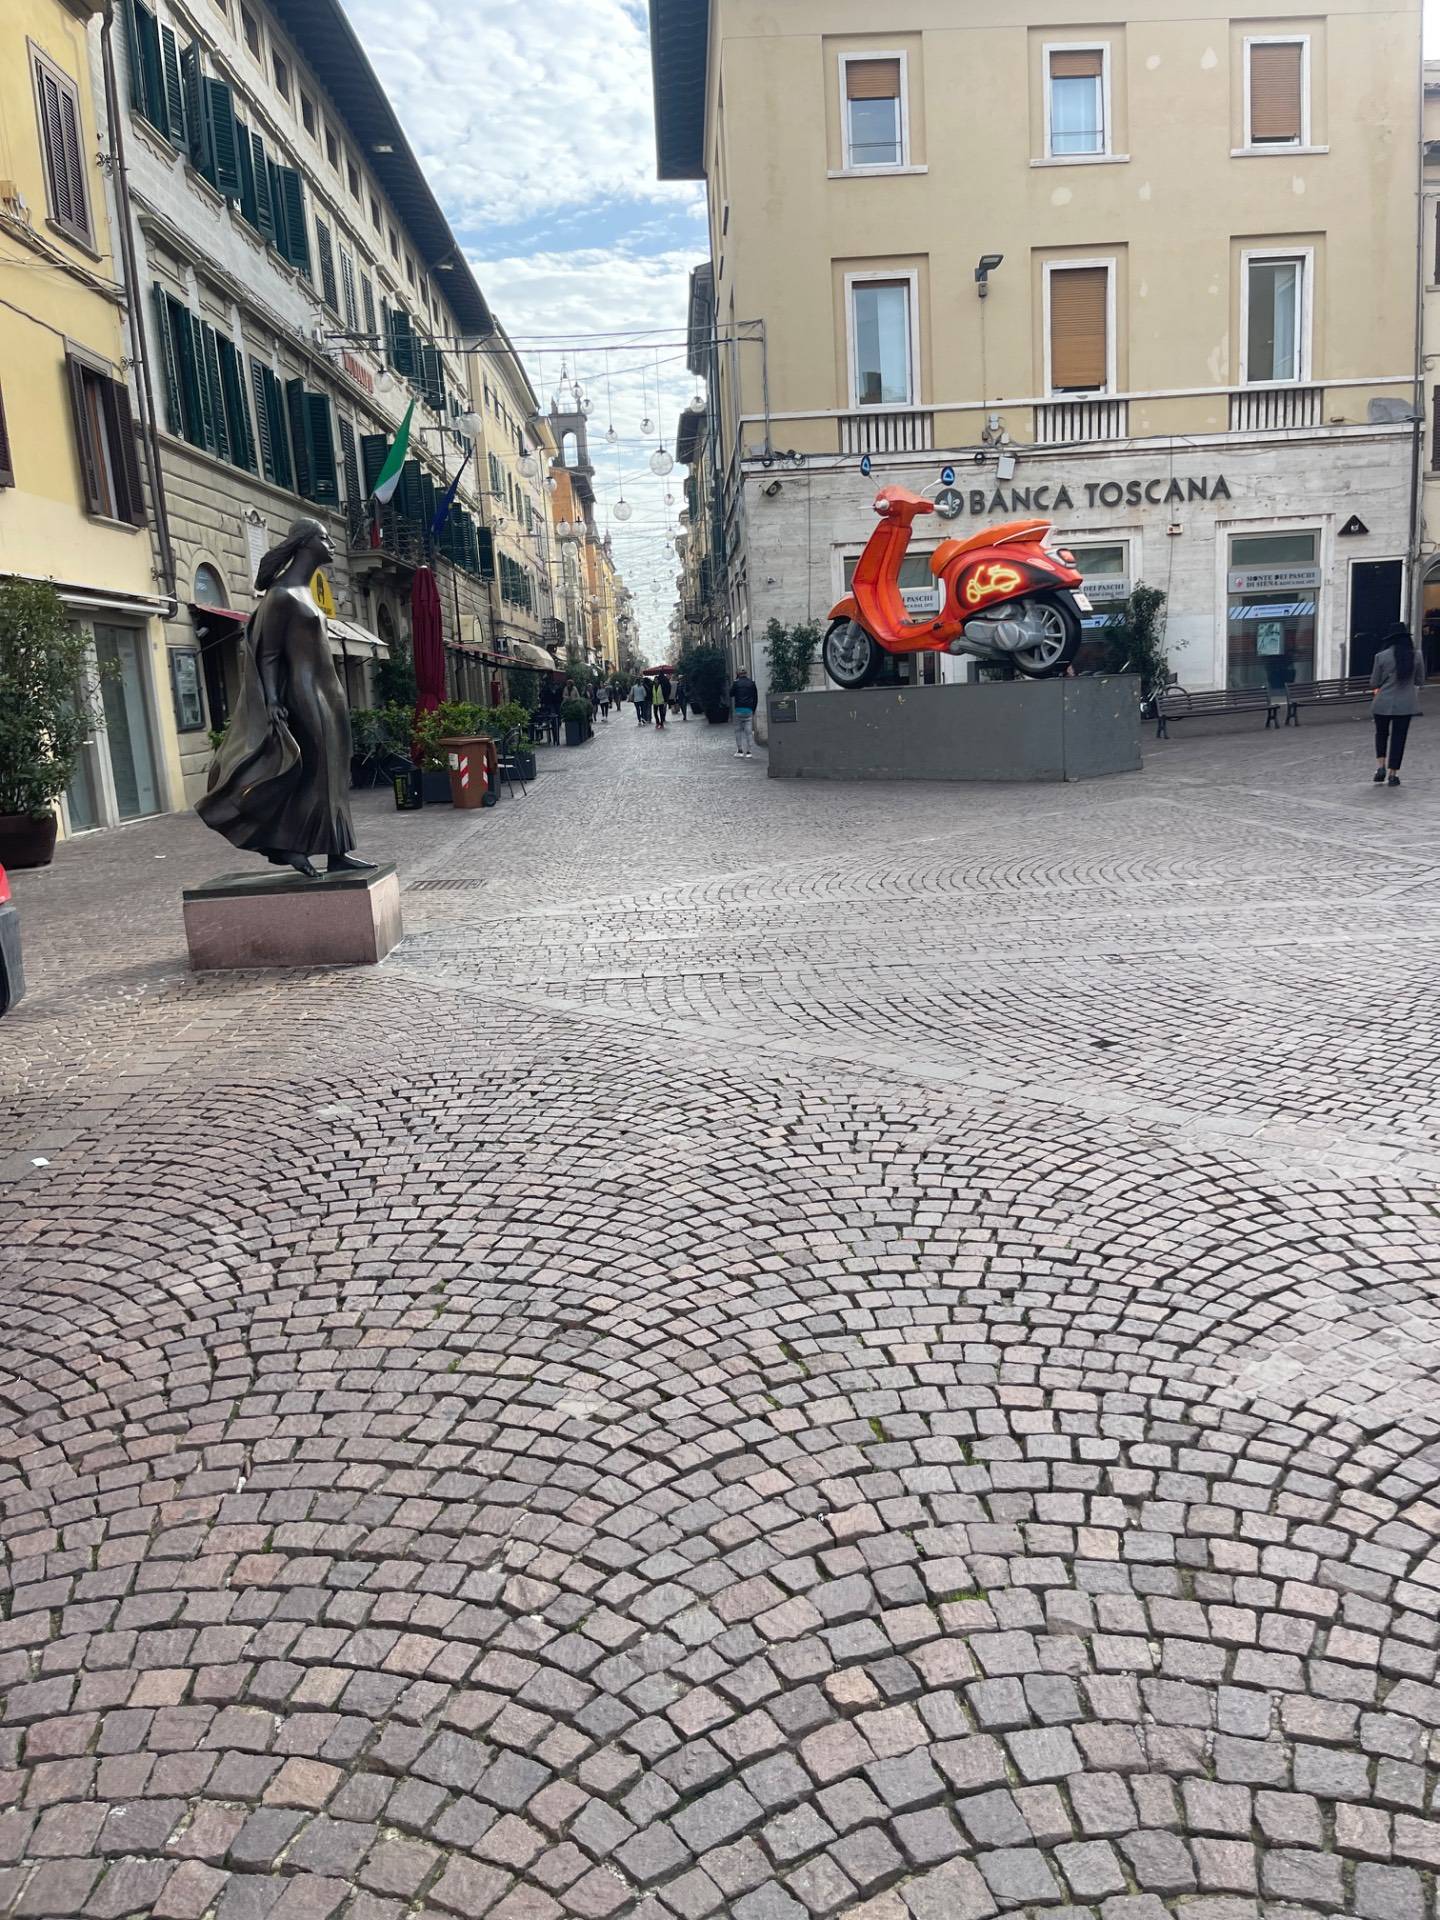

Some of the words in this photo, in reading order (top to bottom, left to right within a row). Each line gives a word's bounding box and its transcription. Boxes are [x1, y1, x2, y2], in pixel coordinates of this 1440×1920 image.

[969, 484, 1074, 515] BANCA
[1084, 474, 1232, 508] TOSCANA
[1097, 583, 1124, 592] PASCHI
[906, 595, 933, 603] PASCHI
